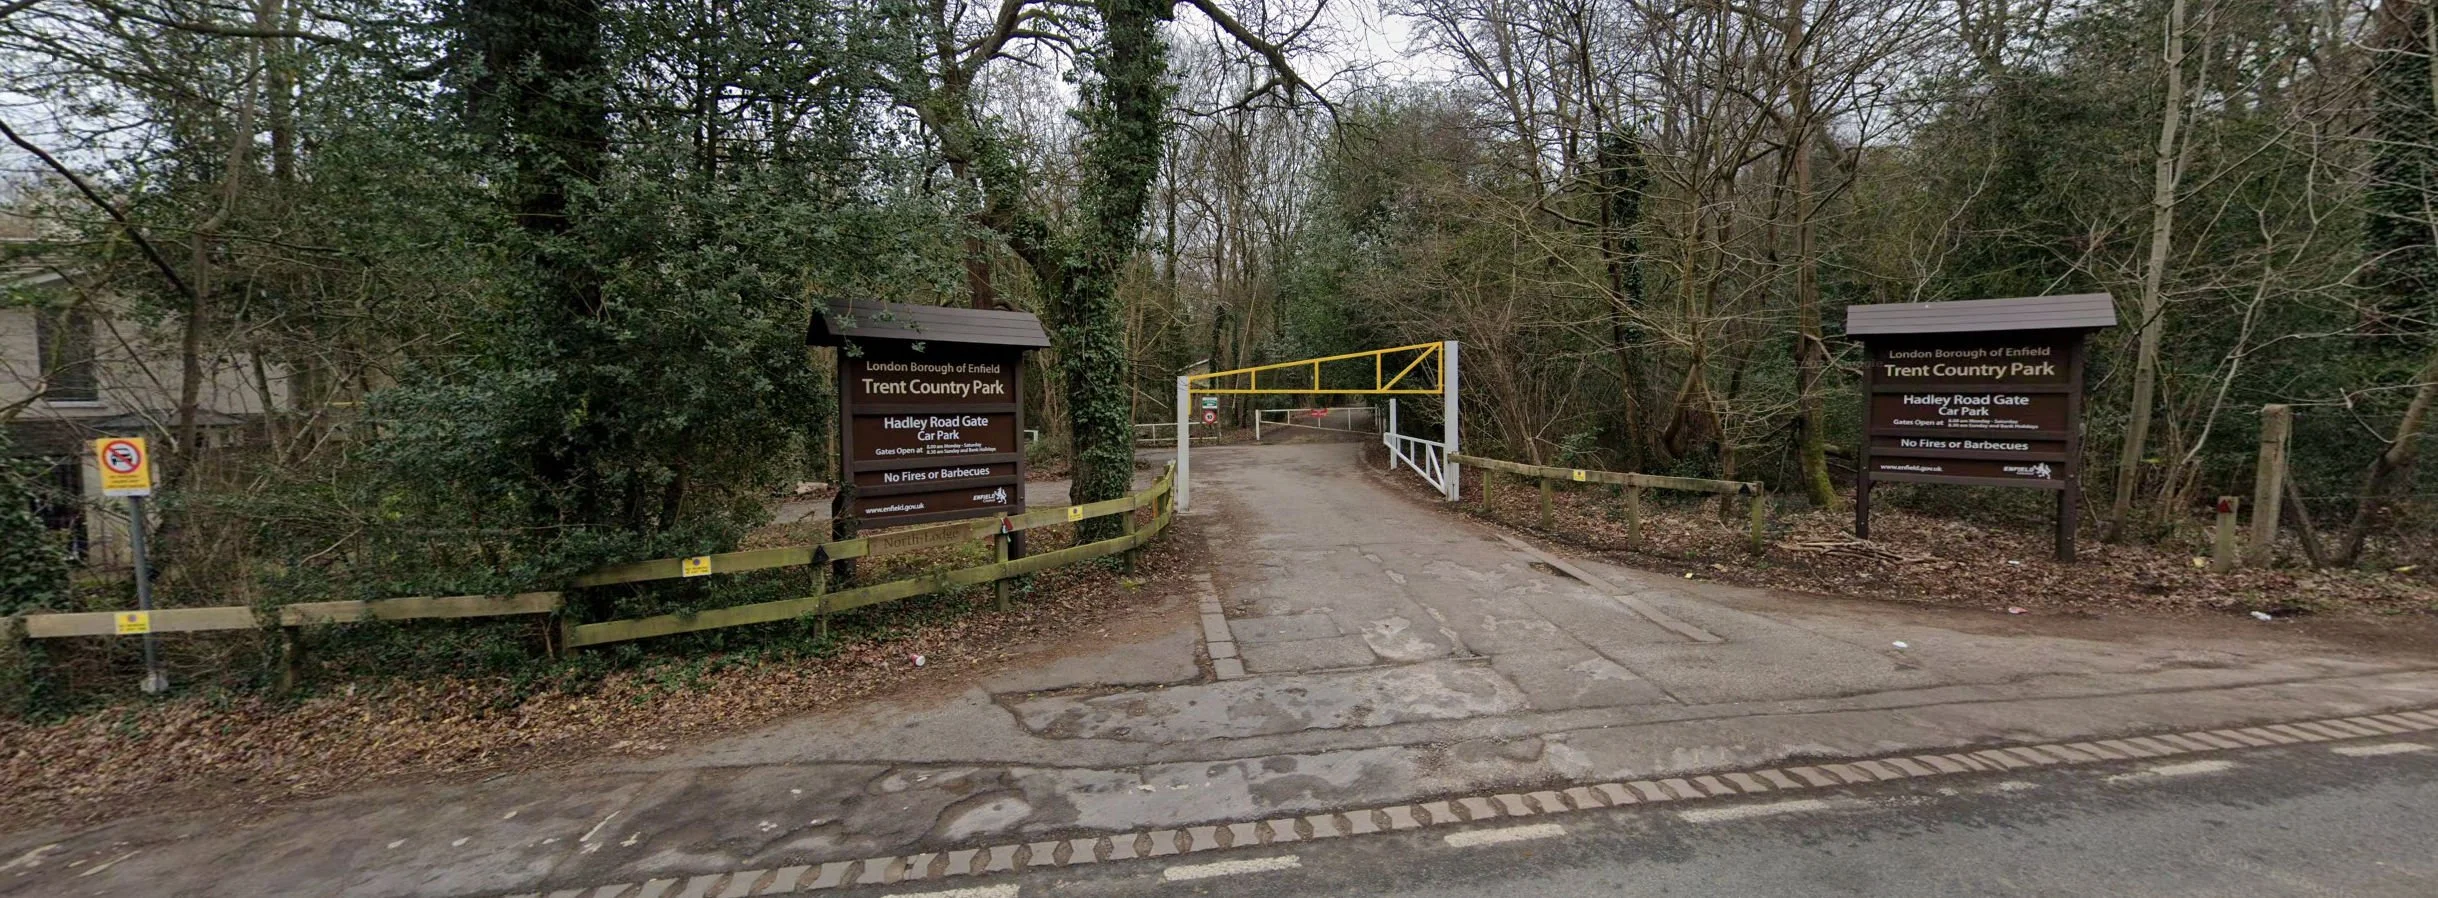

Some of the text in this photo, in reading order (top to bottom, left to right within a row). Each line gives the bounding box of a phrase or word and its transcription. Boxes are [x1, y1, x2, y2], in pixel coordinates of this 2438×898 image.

[1890, 347, 2050, 359] London Borough of Enfield
[867, 361, 1000, 374] London Borough of Enfield
[1884, 364, 1929, 376] Trent
[1933, 364, 2007, 379] Country
[2011, 362, 2055, 376] Park
[862, 379, 1004, 398] Trent Country Park
[1904, 395, 2029, 407] Hadley Road Gate
[1938, 407, 1989, 416] Car Park
[884, 416, 988, 430] Hadley Road Gate
[918, 430, 959, 440] Car Park
[1901, 439, 1917, 447] No
[1920, 439, 1946, 448] Fires
[1964, 440, 2029, 450] Barbecues
[876, 448, 896, 456] Gates
[1880, 464, 1942, 472] www.enfield.gov.uk
[884, 473, 899, 483] No
[902, 472, 926, 481] Fires
[941, 468, 990, 478] Barbecues
[865, 502, 924, 514] www.enfield.gov.uk
[884, 528, 959, 549] North Lodge
